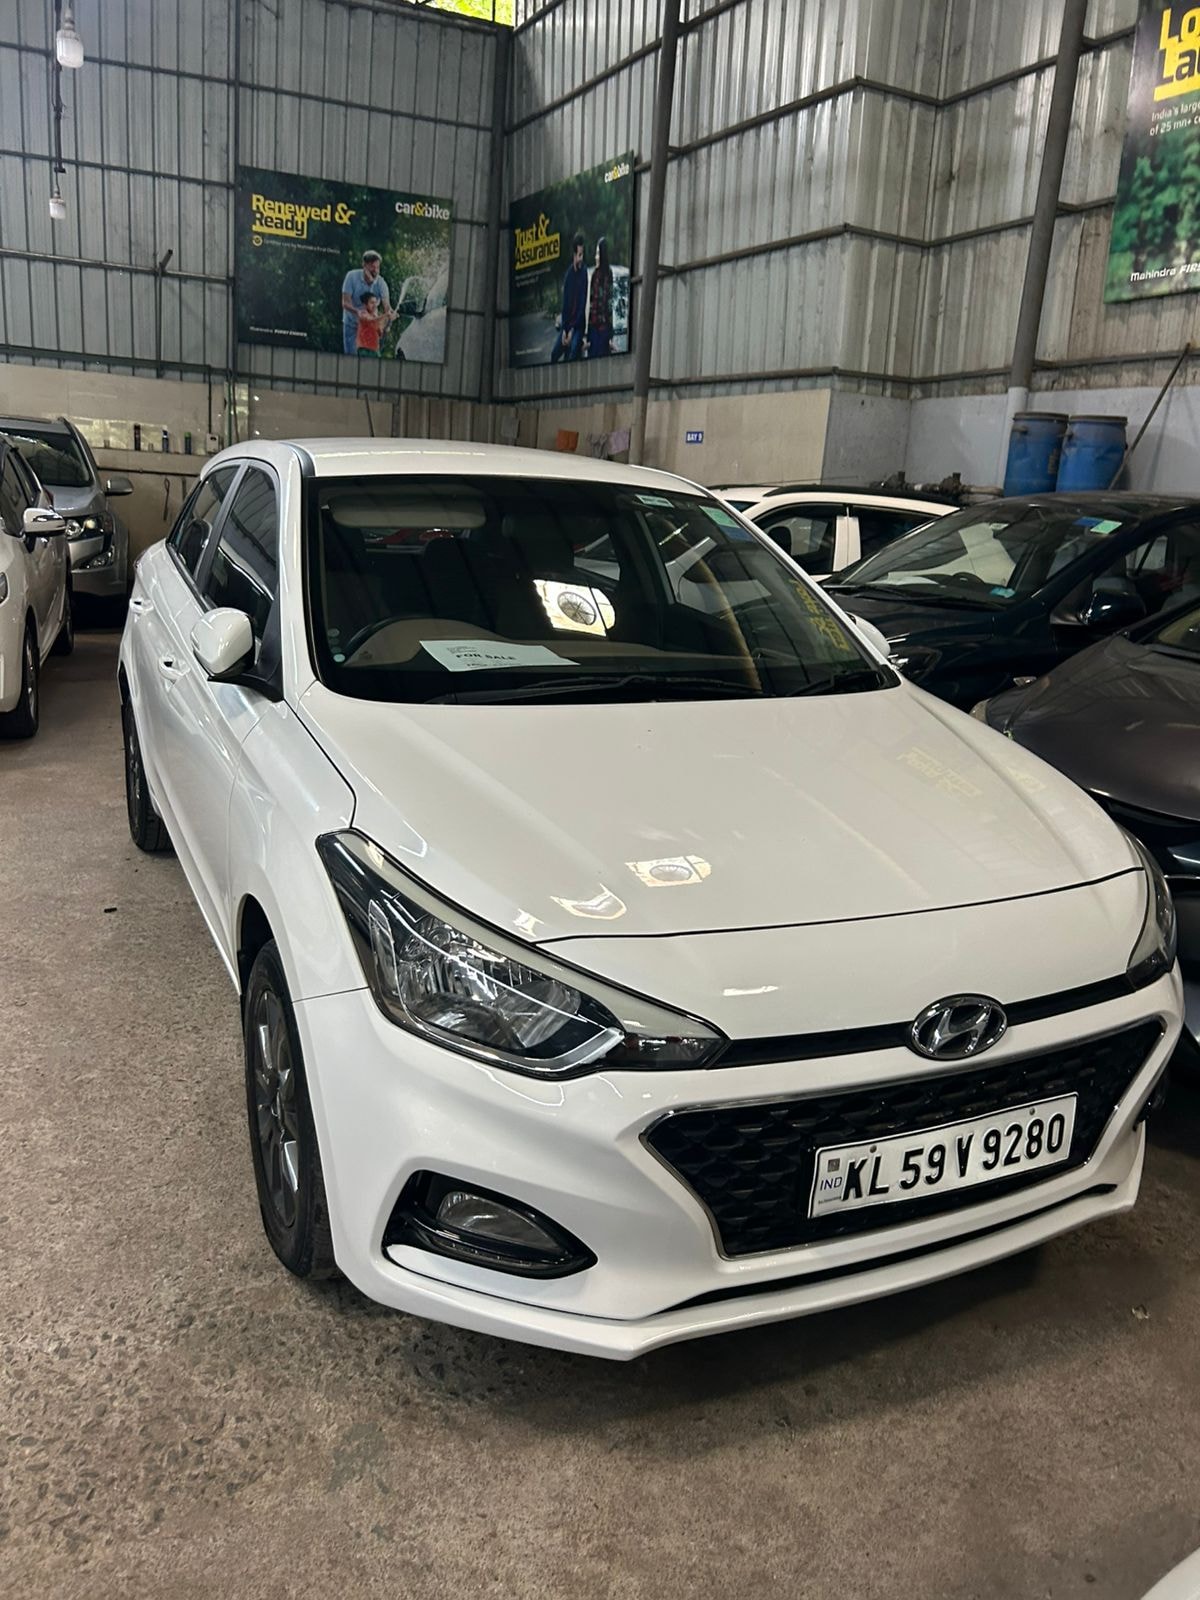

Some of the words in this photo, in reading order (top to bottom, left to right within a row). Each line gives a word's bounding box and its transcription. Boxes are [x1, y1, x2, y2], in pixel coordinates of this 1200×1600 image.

[1151, 105, 1179, 122] India's
[1149, 123, 1159, 136] of
[1160, 120, 1172, 134] 25
[252, 193, 331, 222] Renewed
[334, 202, 356, 225] &
[395, 201, 450, 220] car&bike
[255, 212, 306, 237] Ready
[515, 223, 537, 249] Trust
[538, 212, 550, 239] &
[516, 238, 559, 266] Assurance
[1130, 267, 1177, 282] Mahindra
[841, 1154, 890, 1200] KL
[900, 1143, 946, 1190] 59
[956, 1133, 974, 1178] V
[981, 1112, 1066, 1171] 9280
[820, 1176, 843, 1191] IND
